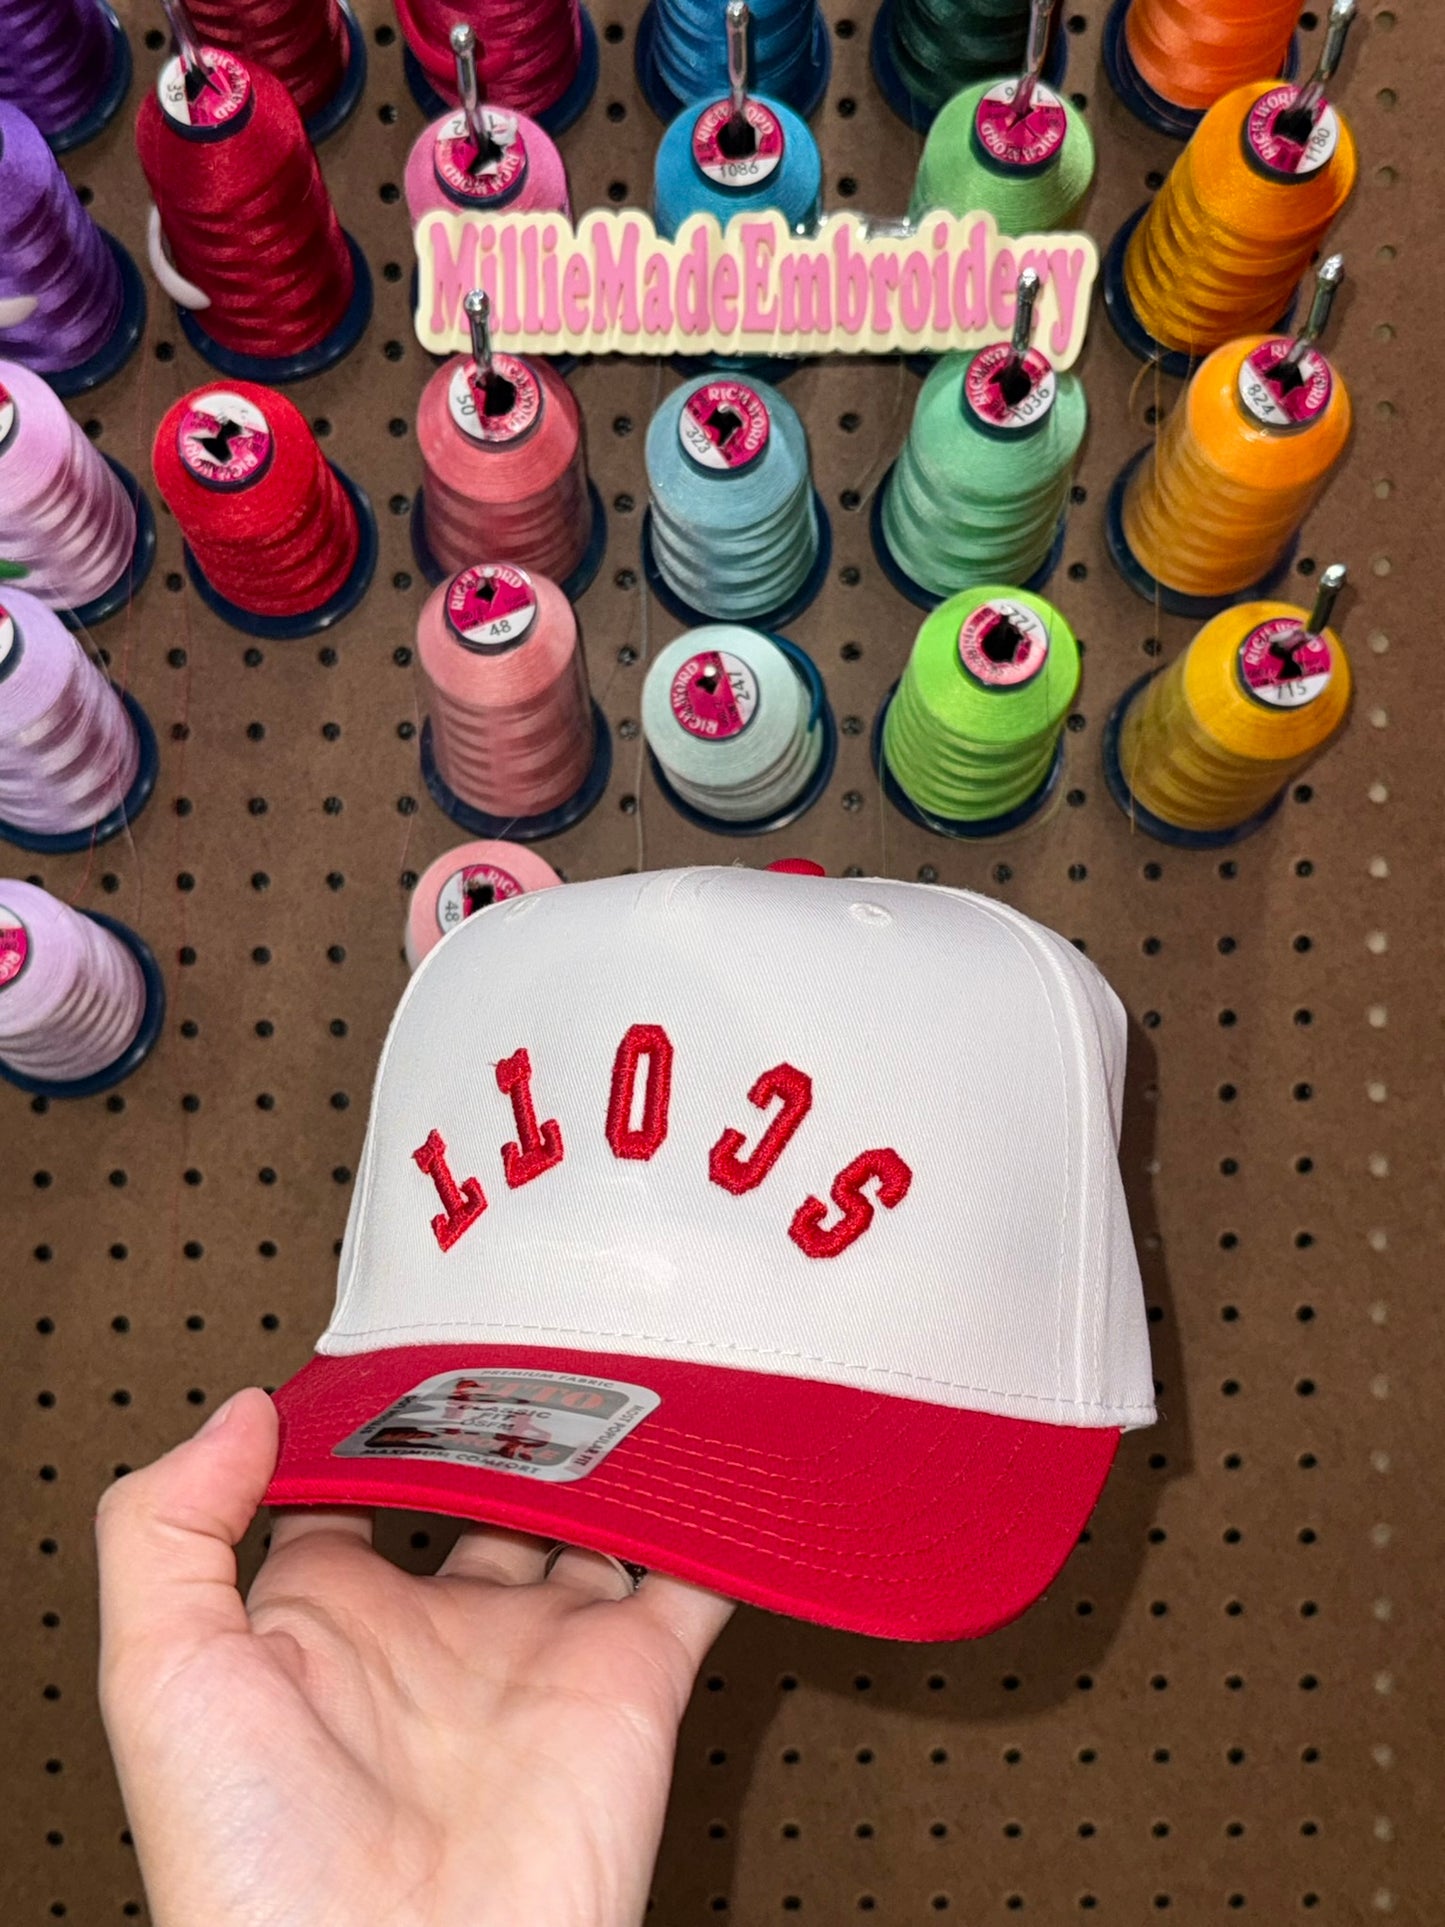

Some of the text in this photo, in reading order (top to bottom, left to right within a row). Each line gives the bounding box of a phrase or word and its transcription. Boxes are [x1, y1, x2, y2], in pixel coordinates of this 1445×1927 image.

[167, 83, 184, 102] 39
[1305, 128, 1330, 164] 1180
[719, 160, 759, 178] 1086
[428, 220, 1085, 354] MillieMadeEmbroidery
[456, 394, 477, 416] 50
[1010, 387, 1050, 421] 1036
[1246, 383, 1275, 416] 824
[686, 424, 711, 455] 323
[489, 619, 512, 638] 48
[727, 671, 751, 706] 247
[445, 900, 460, 922] 48
[412, 1023, 912, 1259] SCOTT
[480, 1369, 615, 1389] PREMIUM FABRIC
[455, 1452, 542, 1475] COMFORT
